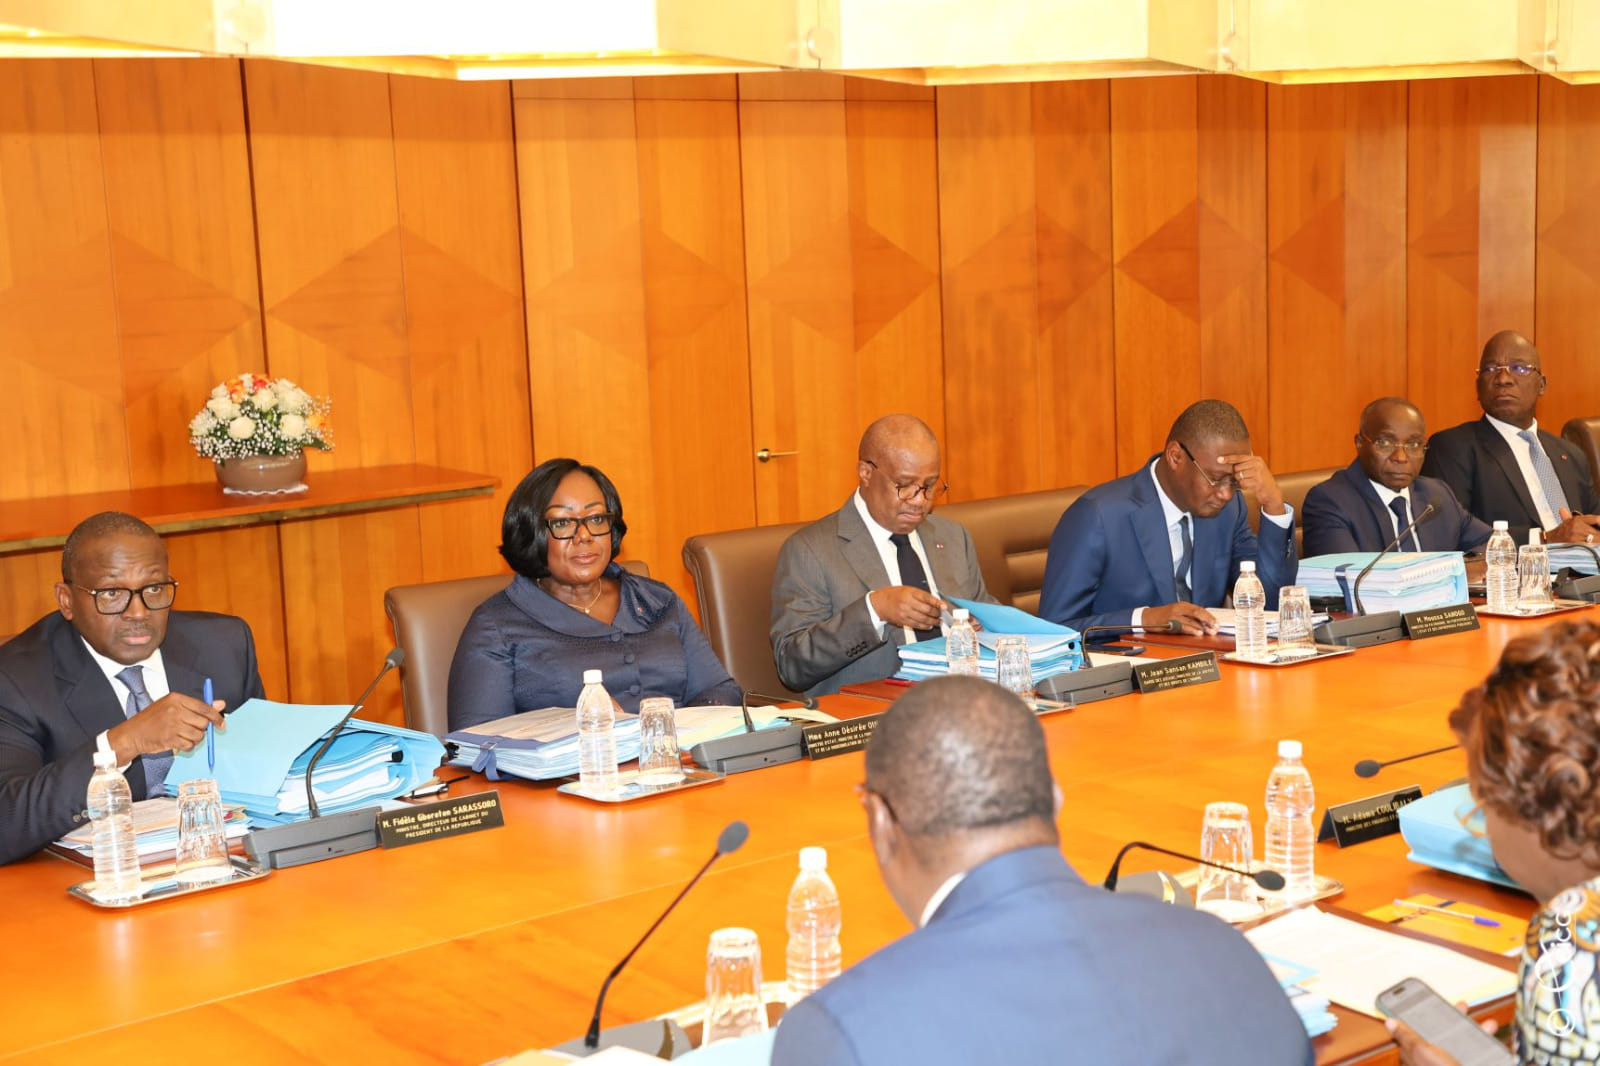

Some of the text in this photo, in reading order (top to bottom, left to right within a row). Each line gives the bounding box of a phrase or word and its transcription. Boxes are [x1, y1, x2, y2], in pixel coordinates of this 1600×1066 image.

[1164, 666, 1186, 674] Sansan
[842, 723, 866, 735] Désirée
[393, 815, 415, 826] Fidèle
[452, 799, 496, 814] SARASSORO
